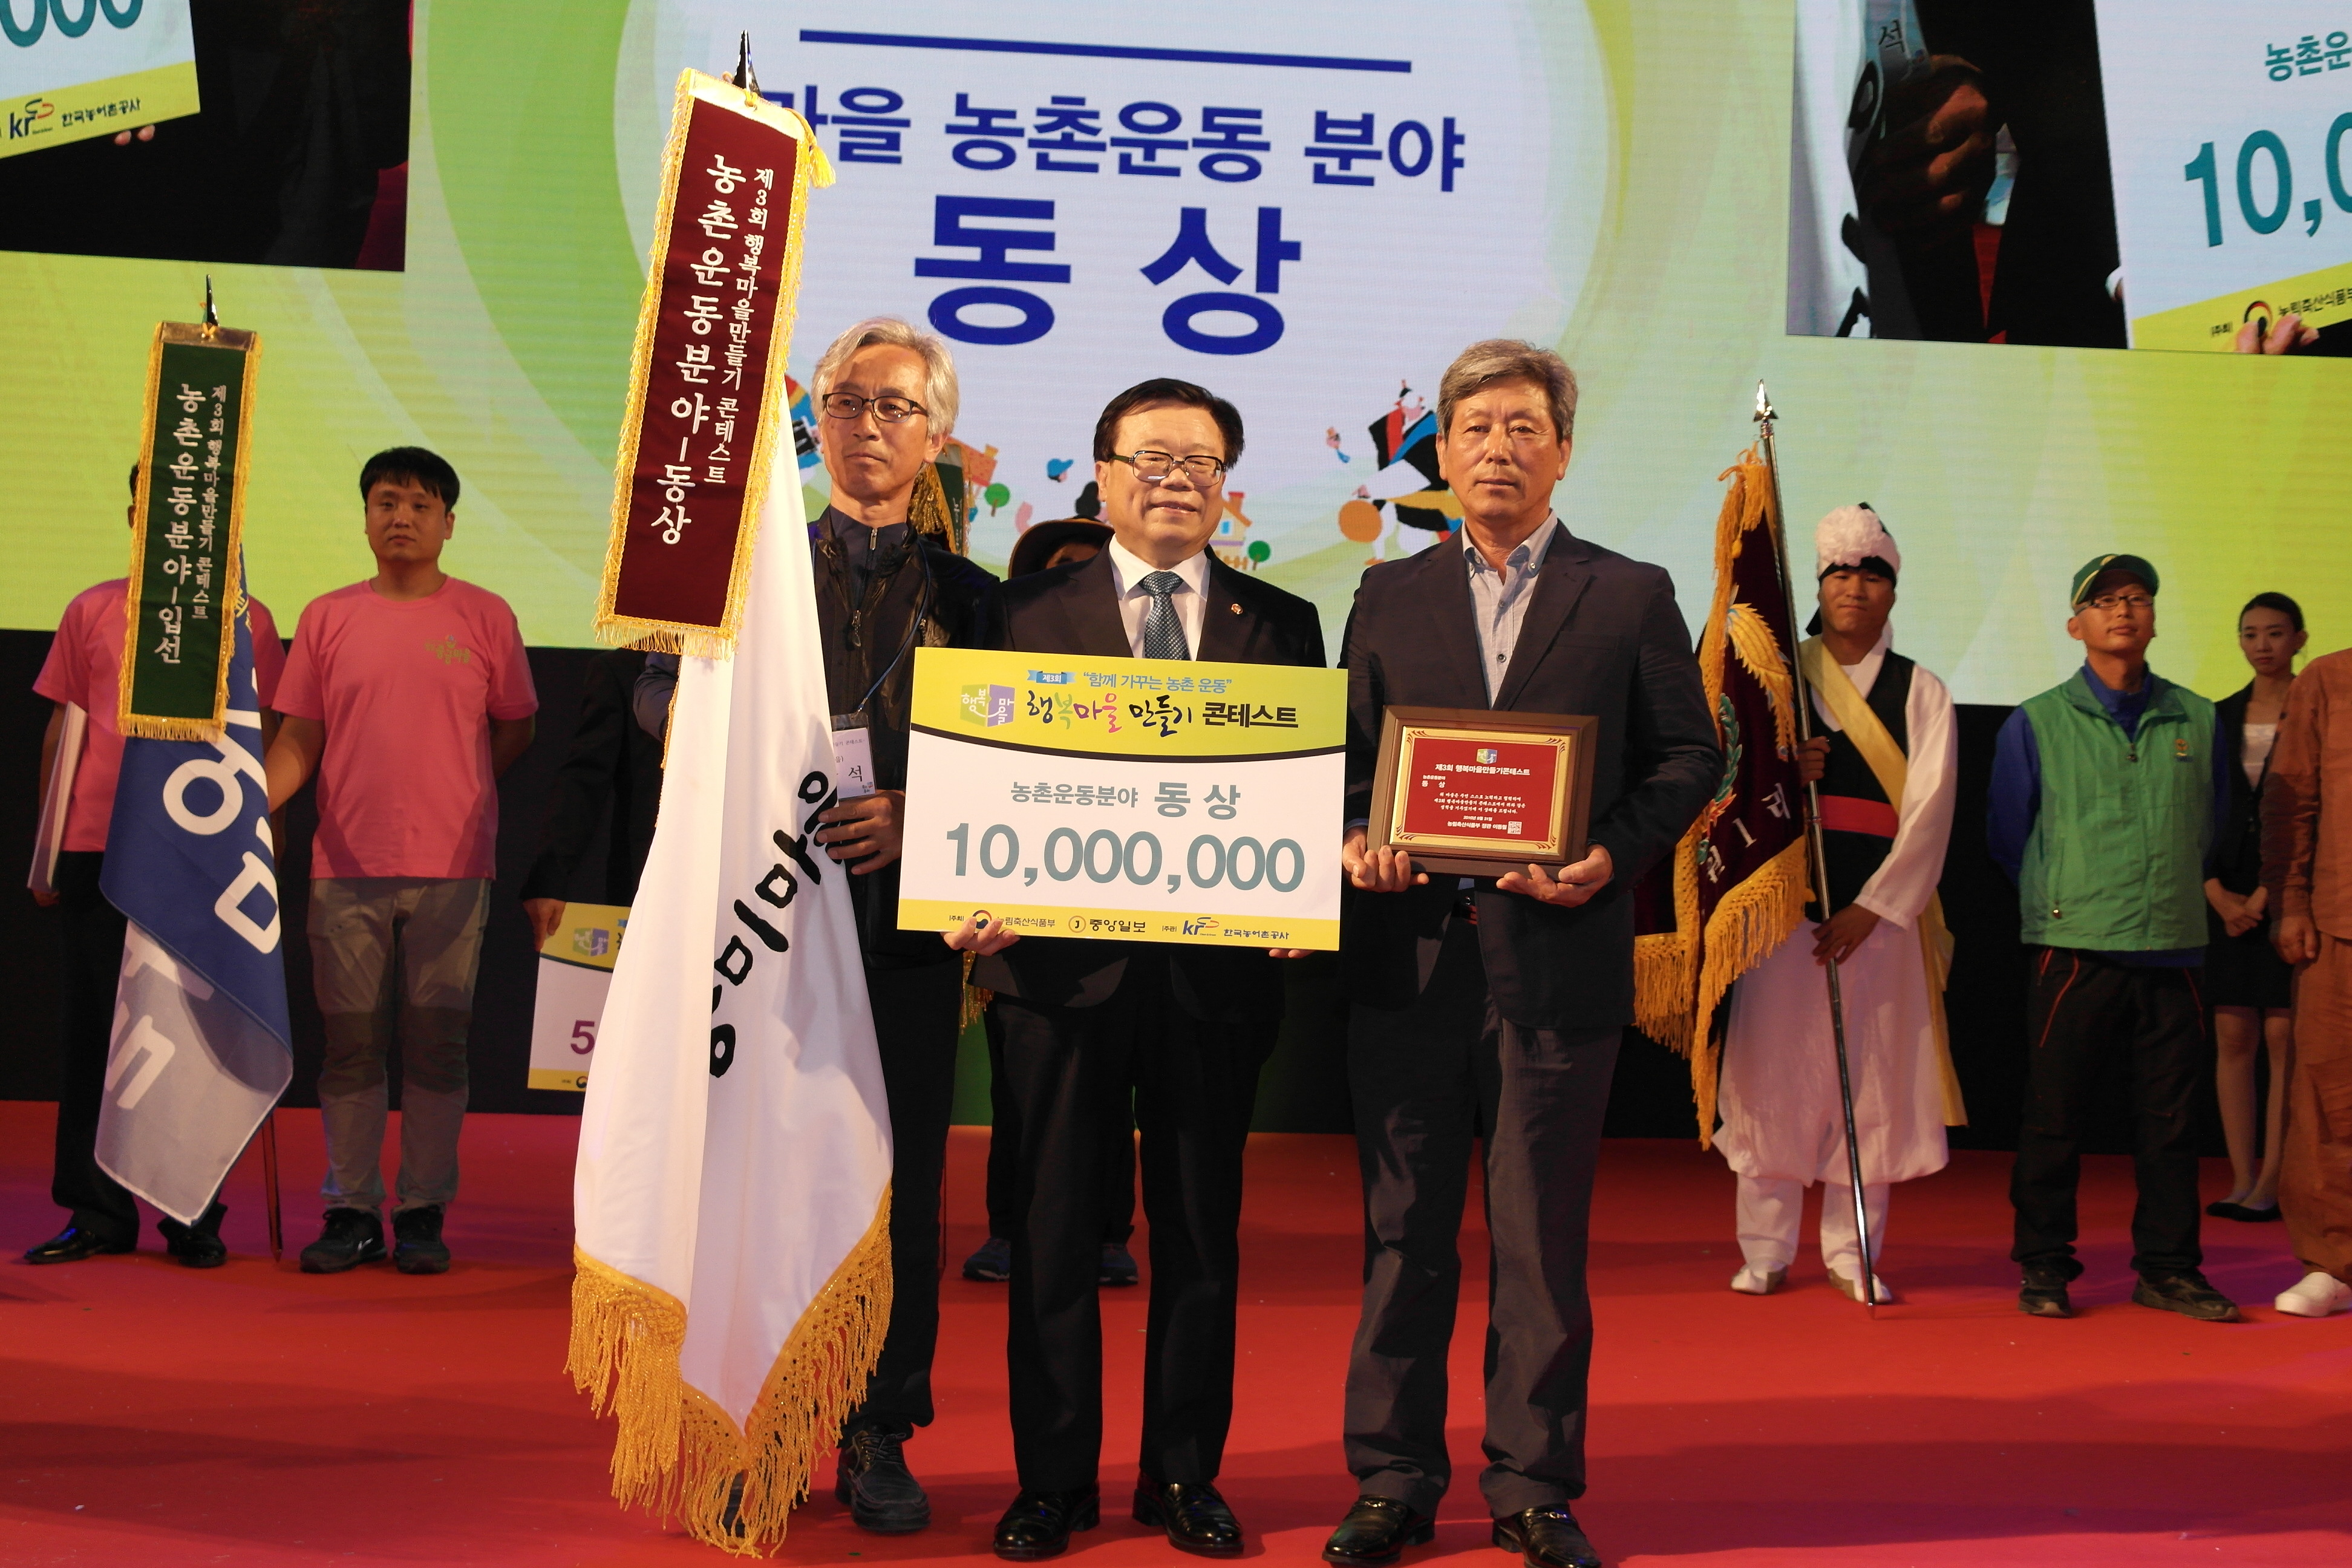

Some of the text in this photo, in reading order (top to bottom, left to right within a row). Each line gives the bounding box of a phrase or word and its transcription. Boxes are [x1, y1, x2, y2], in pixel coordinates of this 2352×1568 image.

[1878, 19, 1905, 53] 석
[945, 92, 1271, 183] 농촌운동
[1305, 109, 1466, 192] 분야
[704, 168, 774, 484] 제3회 행복마을만들기 콘테스트
[191, 385, 227, 619] 제3회 행복마을만들기 콘테스트
[1042, 674, 1062, 683] 제3회
[1121, 675, 1163, 690] 가꾸는
[1166, 676, 1195, 692] 농촌
[1027, 690, 1299, 737] 행복마을 만들기 콘테스트
[848, 765, 863, 782] 석
[1435, 763, 1530, 776] 제3회 행복마을만들기콘테스트
[1011, 782, 1241, 820] 농촌운동분야 동 상
[946, 823, 1305, 895] 10,000,000
[998, 916, 1056, 928] 림축산식품부
[1089, 919, 1146, 933] 중앙일보
[1224, 929, 1289, 940] 한국농어촌공사
[570, 1019, 595, 1055] 5
